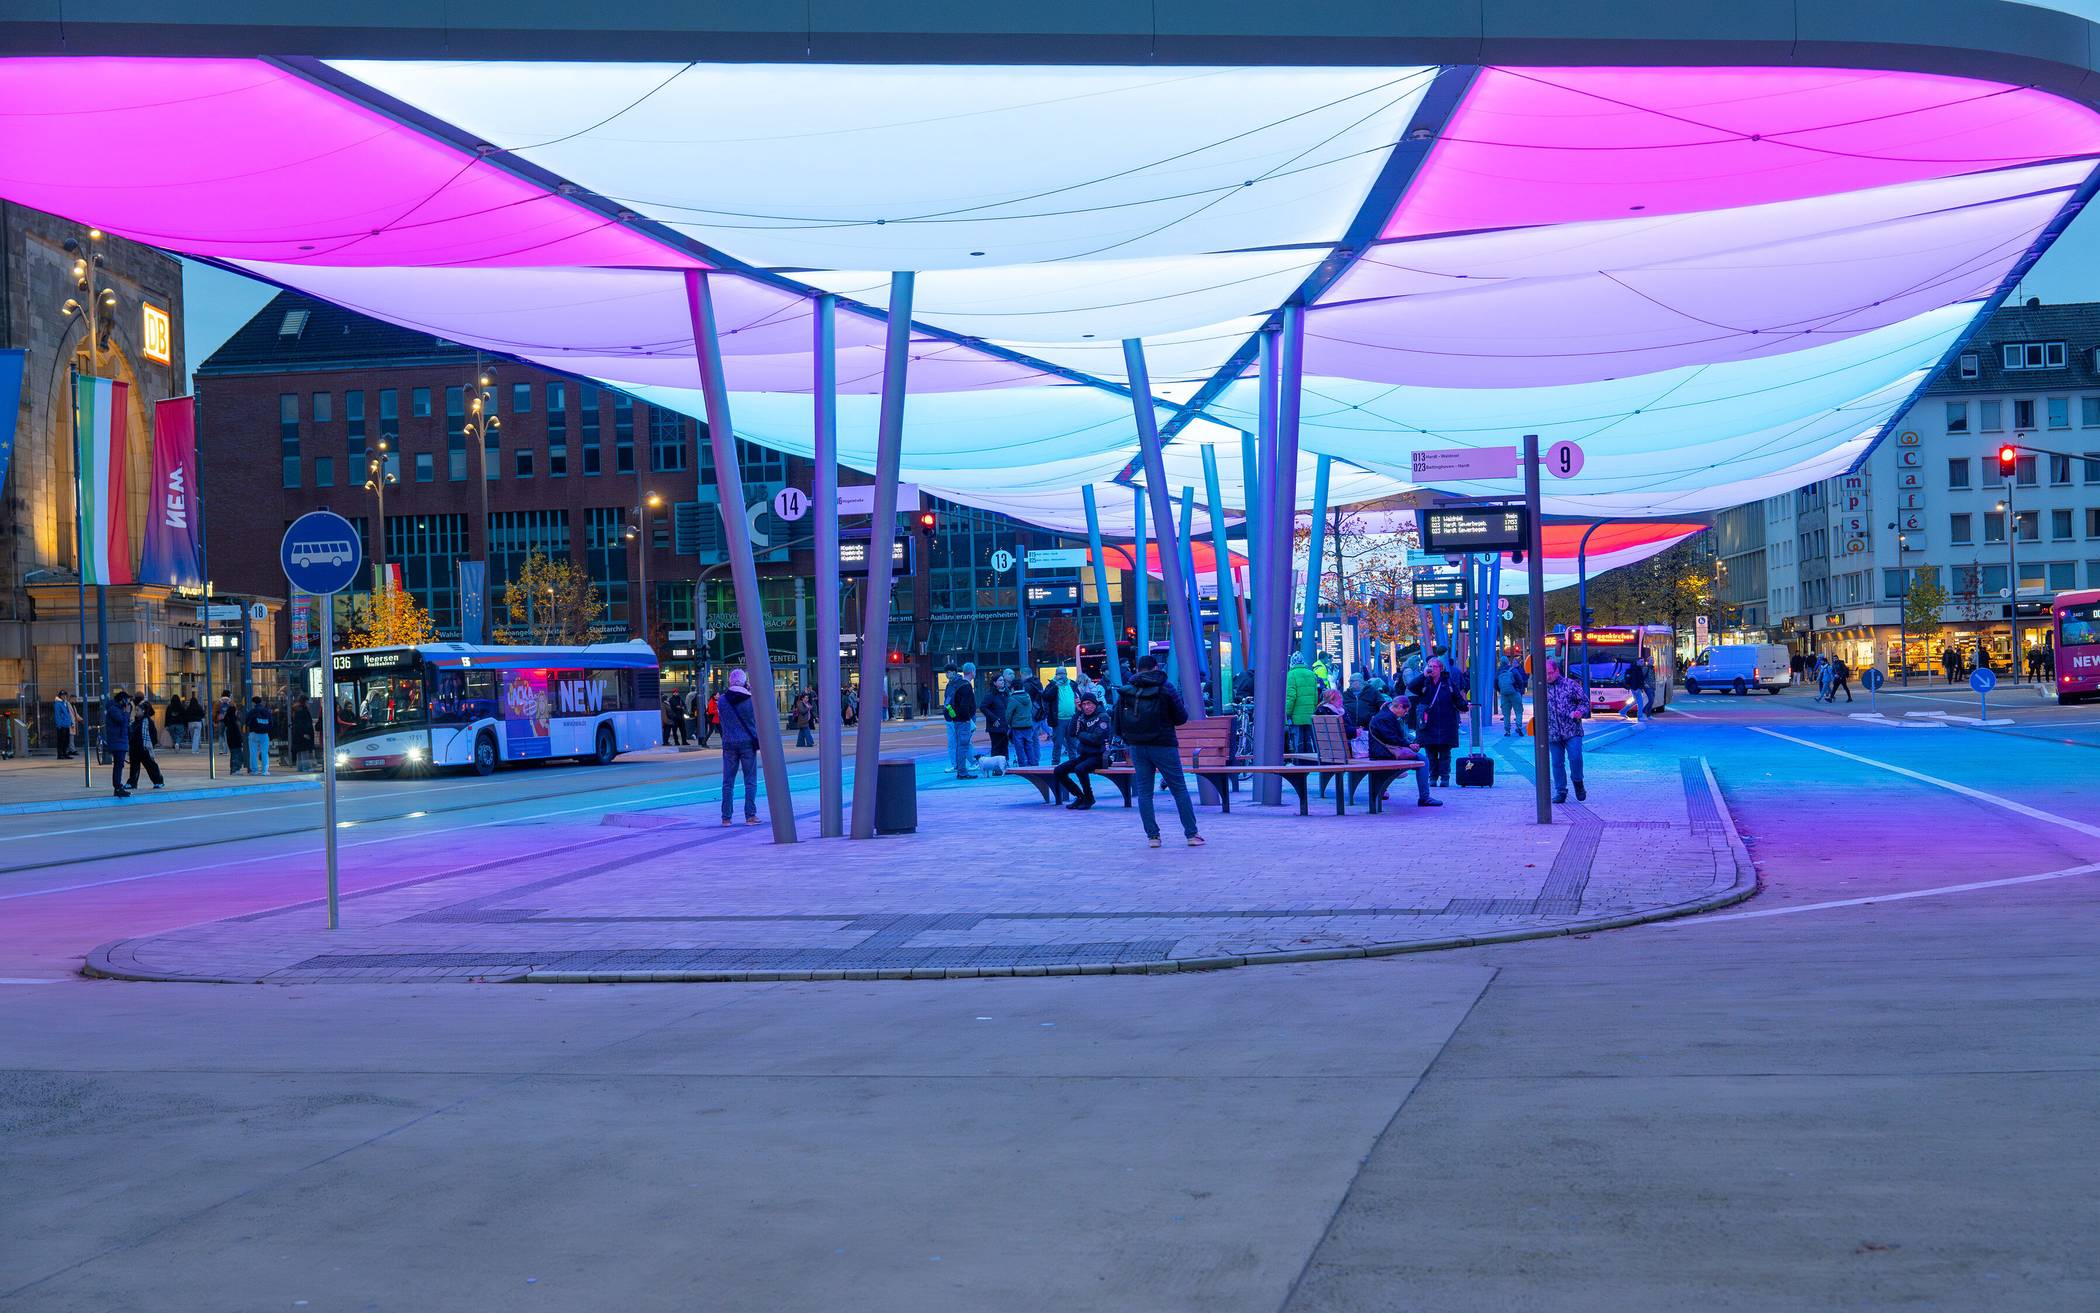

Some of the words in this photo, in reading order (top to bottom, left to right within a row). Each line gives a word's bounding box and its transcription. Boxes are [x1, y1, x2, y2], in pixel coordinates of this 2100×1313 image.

[147, 313, 167, 355] DB
[1413, 452, 1426, 462] 013
[1560, 446, 1571, 474] 9
[1413, 462, 1426, 472] 023
[781, 492, 798, 516] 14
[995, 553, 1008, 569] 13
[254, 605, 264, 618] 18
[1500, 601, 1505, 610] 7
[333, 656, 351, 669] 036
[363, 654, 399, 665] Neersen
[769, 655, 797, 663] CENTER
[2073, 656, 2100, 668] NEW
[560, 679, 605, 713] NEW
